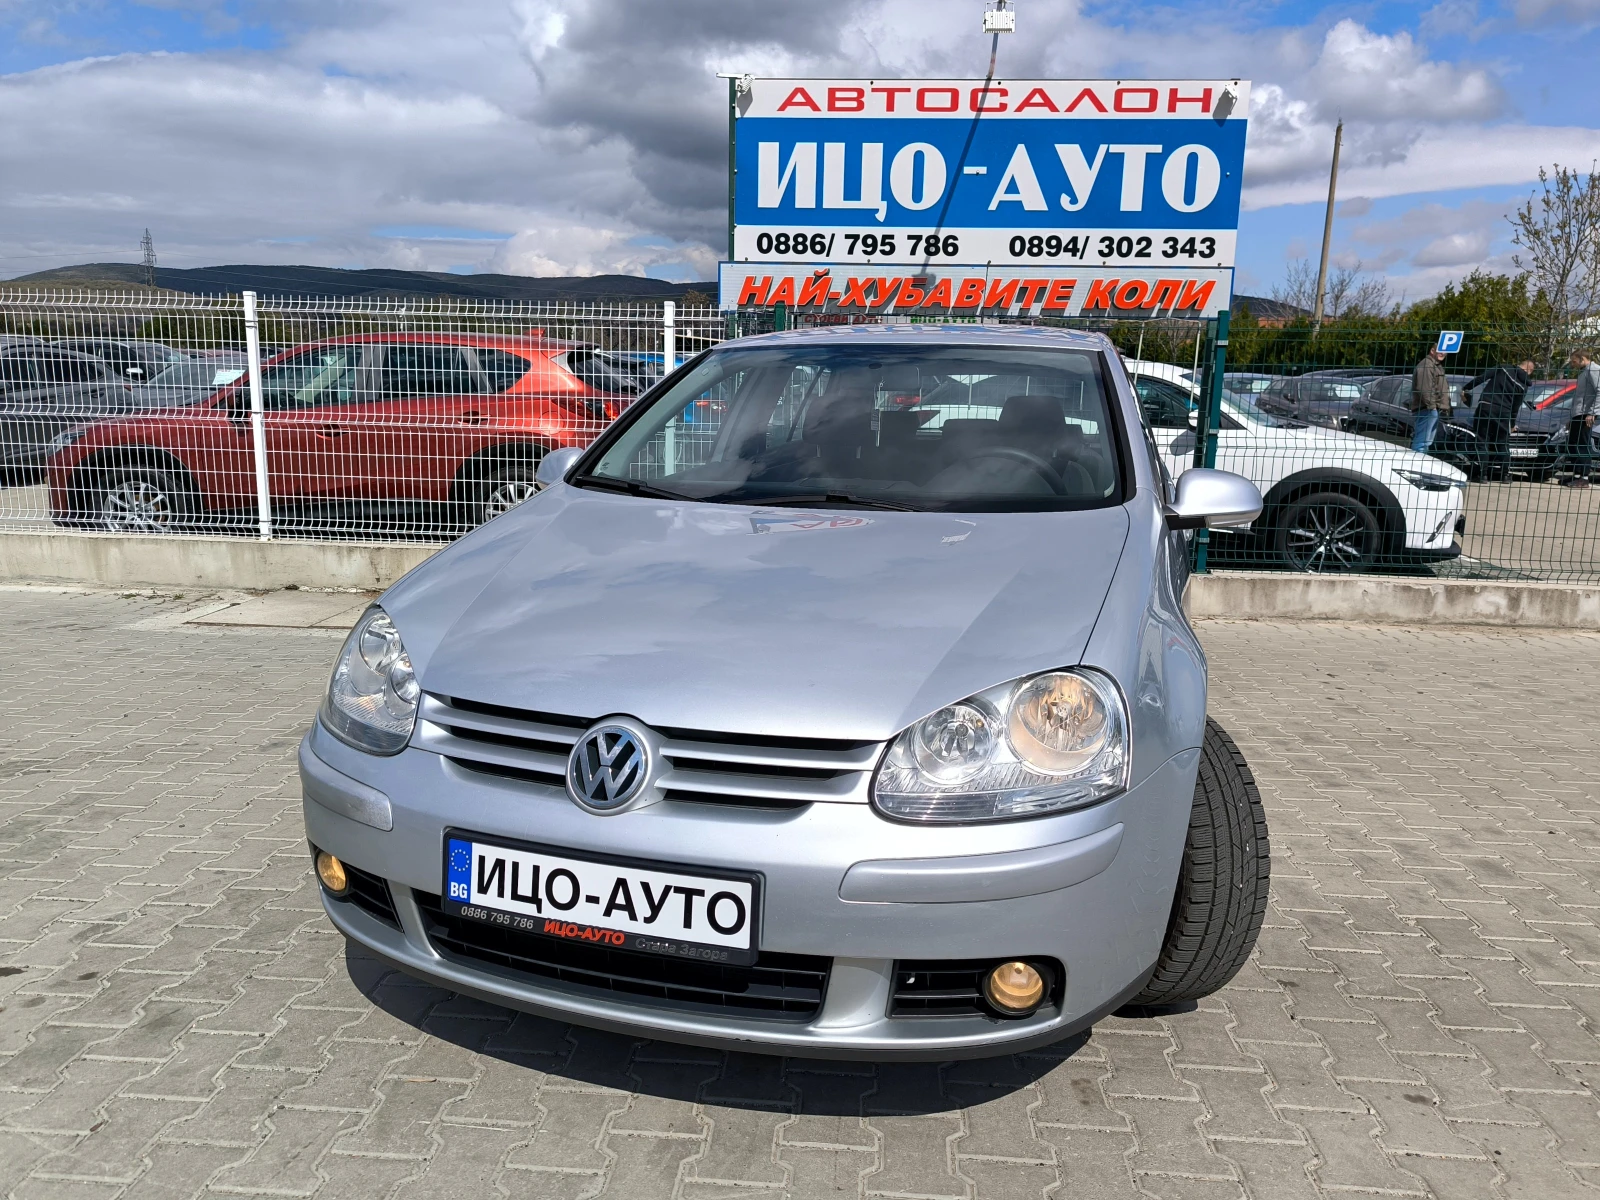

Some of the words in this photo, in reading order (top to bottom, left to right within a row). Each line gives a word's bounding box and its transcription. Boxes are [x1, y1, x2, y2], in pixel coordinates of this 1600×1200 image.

[776, 87, 1213, 113] АВТОСАЛОН
[757, 142, 1221, 223] ИЦО-АУТО
[756, 232, 835, 257] 0886/
[844, 234, 896, 256] 795
[907, 234, 959, 256] 786
[1009, 235, 1090, 259] 0894/
[1097, 236, 1153, 258] 302
[1161, 236, 1216, 258] 343
[736, 268, 1078, 310] НАЙ-ХУБАВИТЕ
[1082, 278, 1217, 310] КОЛИ
[1442, 333, 1457, 350] P
[450, 881, 468, 899] BG
[477, 854, 746, 935] ИЦО-АУТО
[461, 906, 487, 919] 0886
[490, 912, 510, 924] 795
[513, 917, 534, 929] 786
[543, 919, 625, 945] ИЦО-АУТО
[635, 938, 676, 954] Стара
[680, 943, 728, 960] Загора
